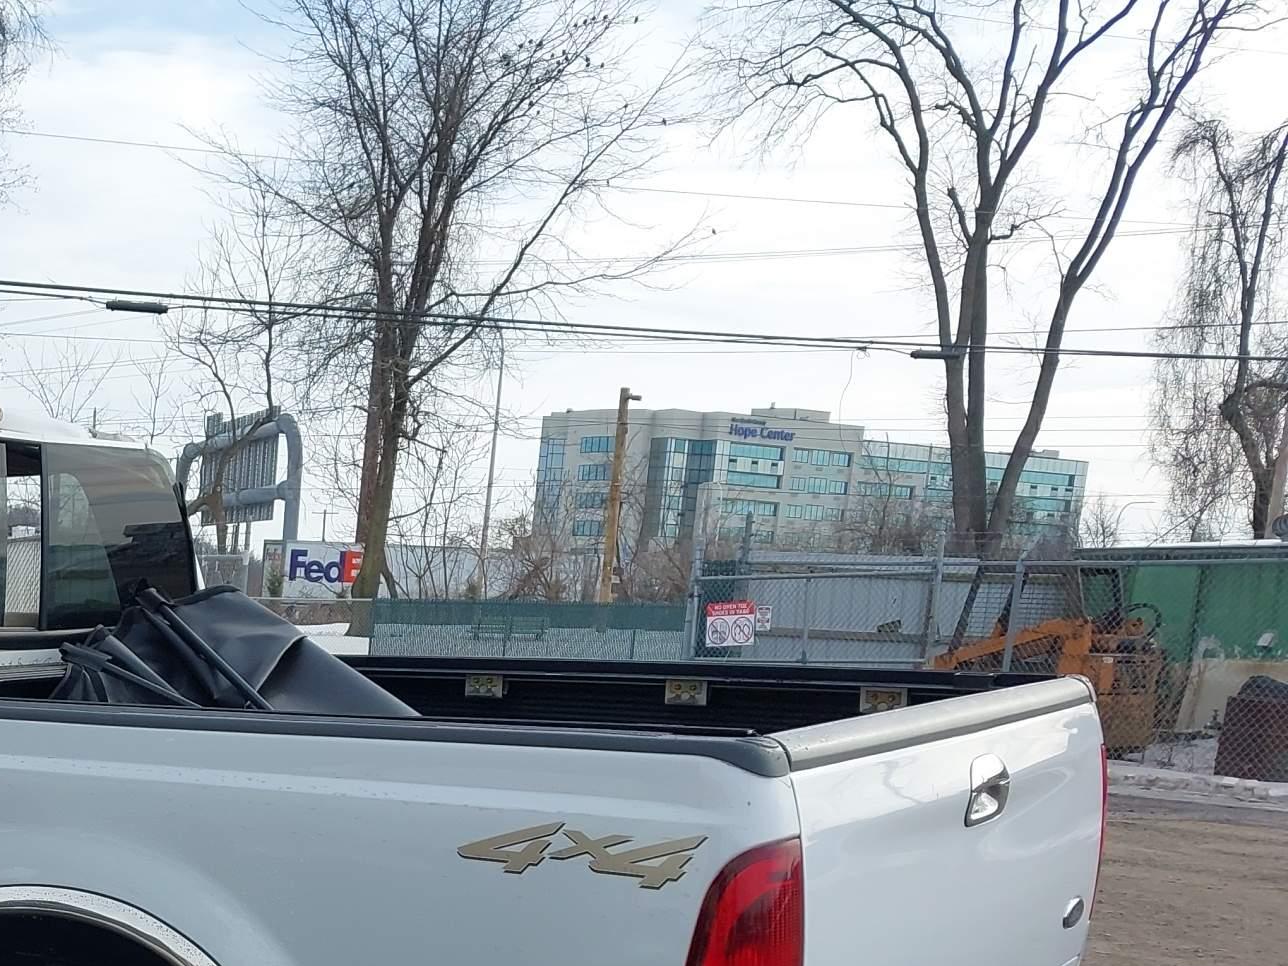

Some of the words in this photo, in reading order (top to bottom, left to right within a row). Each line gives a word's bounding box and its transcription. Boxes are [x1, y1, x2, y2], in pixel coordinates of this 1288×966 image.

[729, 423, 758, 440] Hope
[760, 427, 795, 442] Center
[288, 548, 363, 583] FedE
